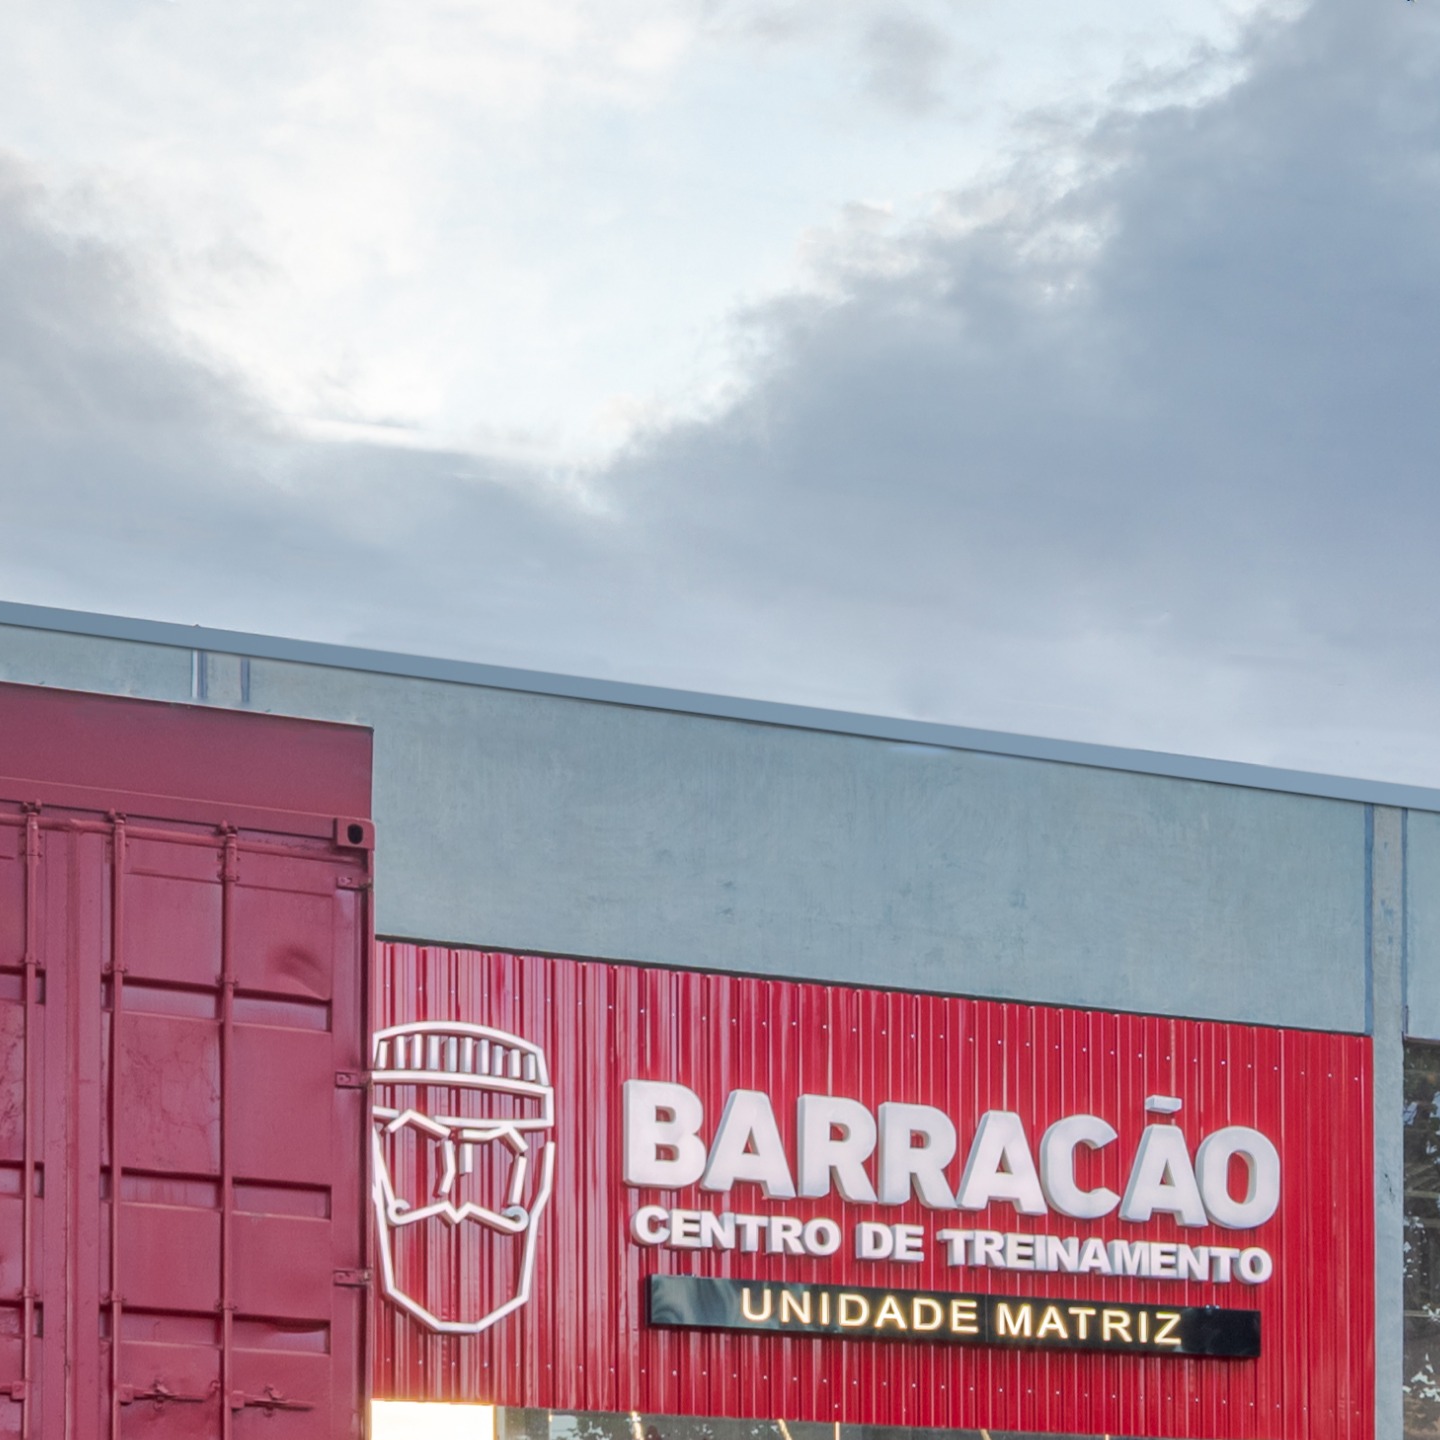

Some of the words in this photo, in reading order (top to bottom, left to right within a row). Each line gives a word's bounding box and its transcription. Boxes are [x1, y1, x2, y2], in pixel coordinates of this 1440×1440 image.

[623, 1079, 1280, 1230] BARRACÃO
[631, 1205, 841, 1256] CENTRO
[855, 1222, 924, 1262] DE
[937, 1228, 1273, 1285] TREINAMENTO
[741, 1286, 979, 1334] UNIDADE
[996, 1302, 1182, 1345] MATRIZ
